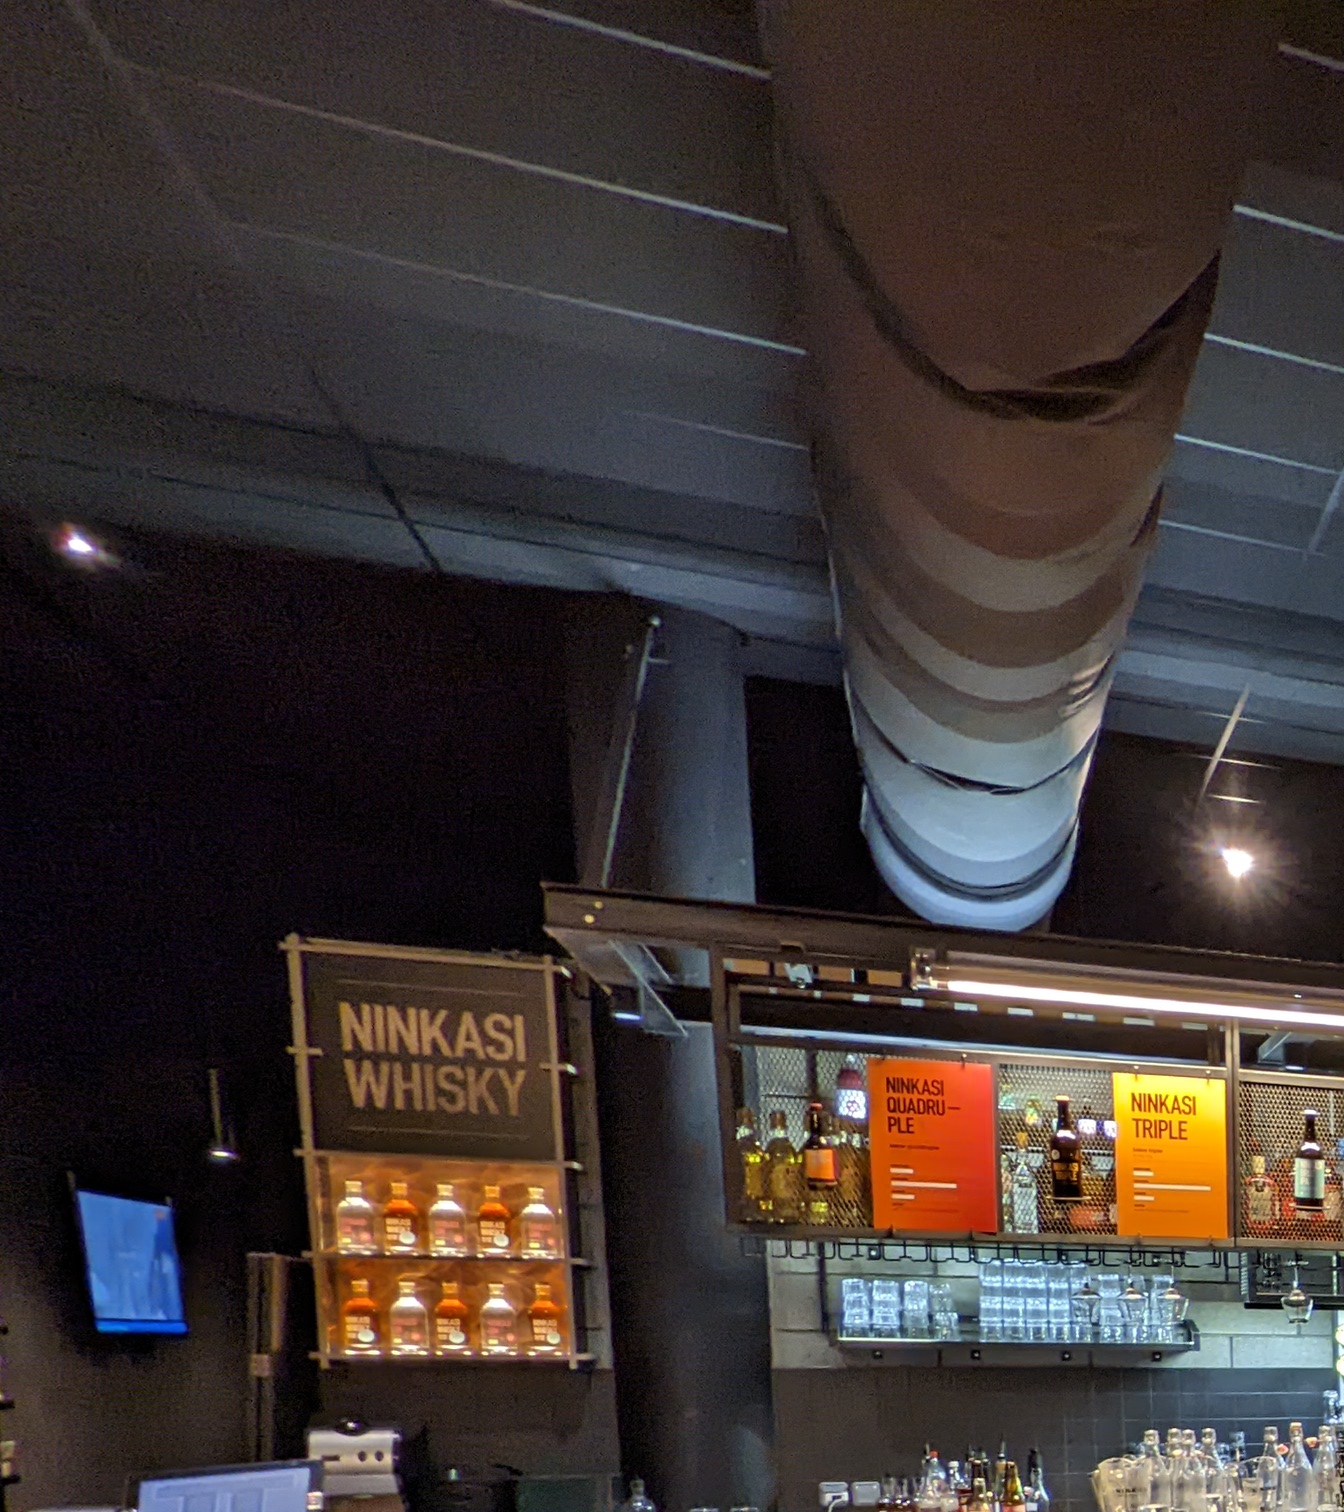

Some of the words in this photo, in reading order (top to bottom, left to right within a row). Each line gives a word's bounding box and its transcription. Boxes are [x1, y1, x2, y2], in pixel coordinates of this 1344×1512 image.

[339, 1002, 527, 1062] NINKASI
[343, 1058, 526, 1116] WHISKY
[886, 1077, 944, 1097] NINKASI
[1131, 1092, 1197, 1116] NINKASI
[888, 1117, 915, 1134] PLE
[1132, 1118, 1188, 1141] TRIPLE
